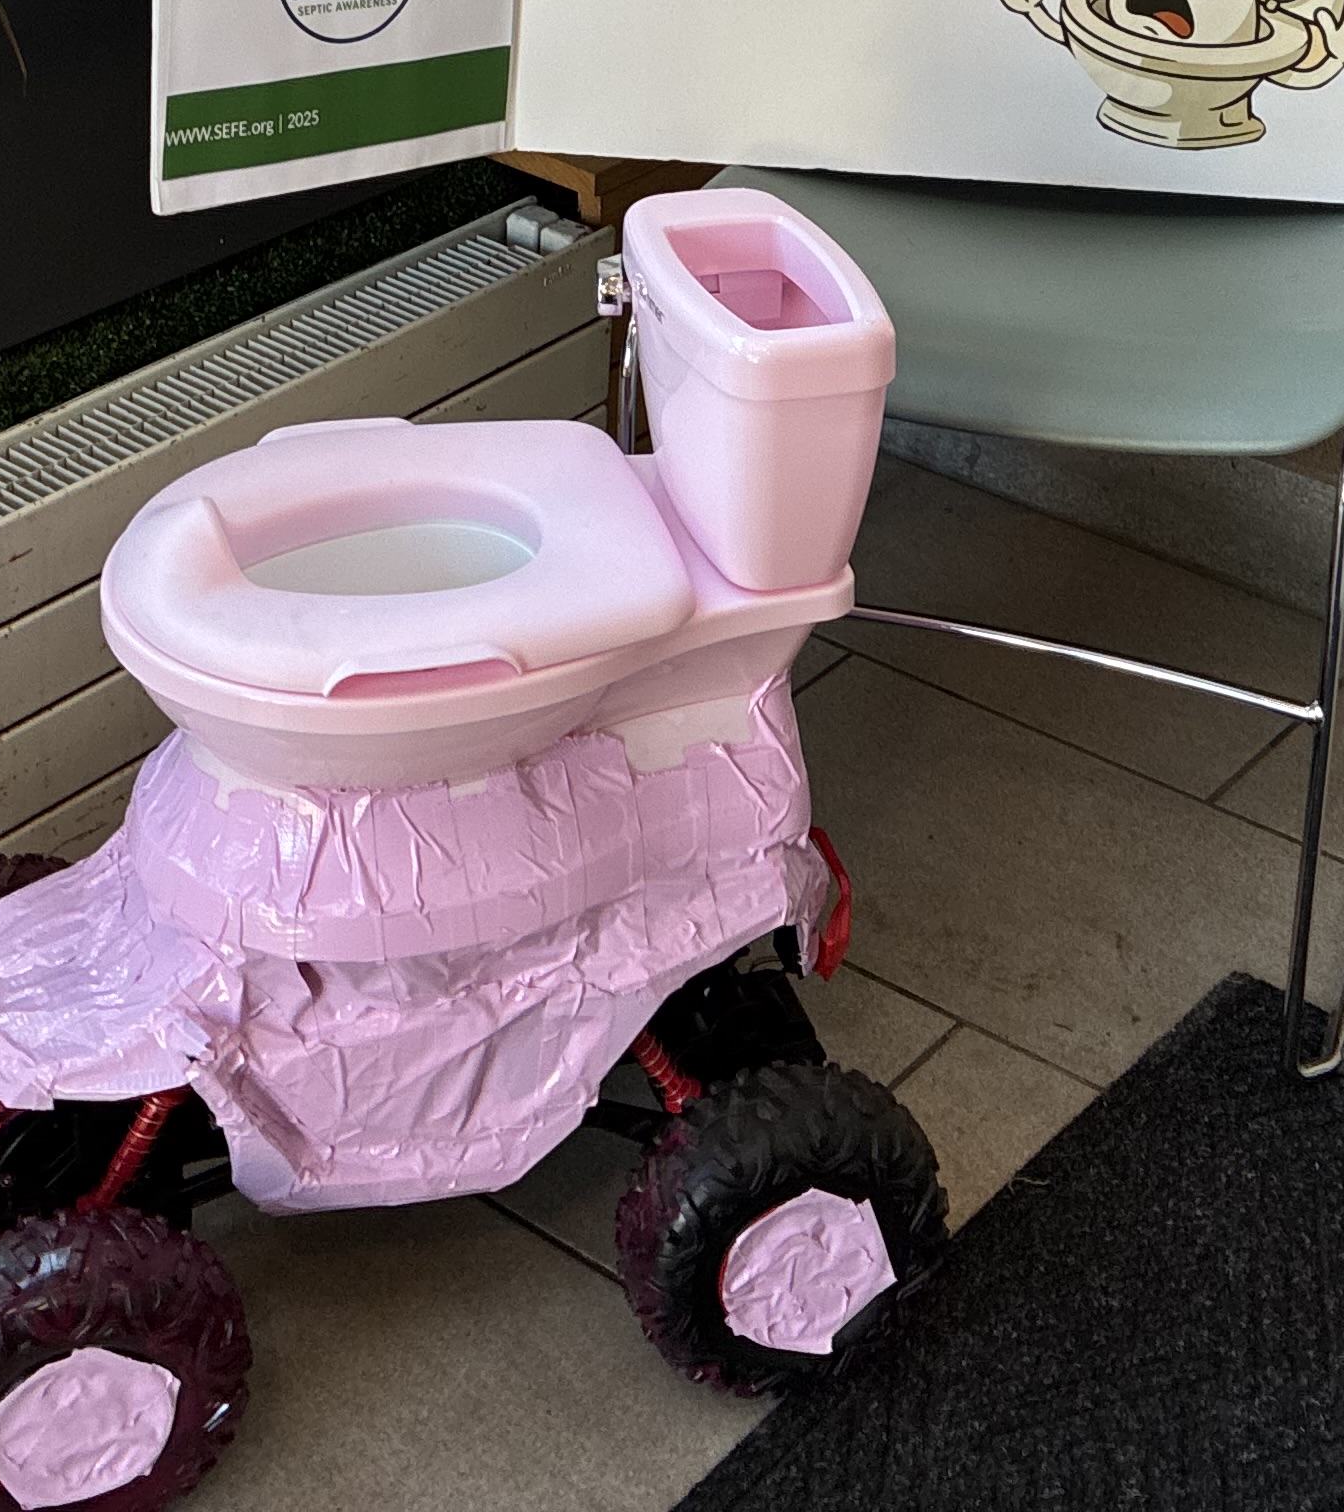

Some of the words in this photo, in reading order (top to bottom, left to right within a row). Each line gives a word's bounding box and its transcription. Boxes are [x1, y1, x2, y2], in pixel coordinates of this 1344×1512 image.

[297, 1, 333, 17] SEPTIC
[165, 118, 274, 147] WWW.SEFE.org
[287, 109, 320, 130] 2025
